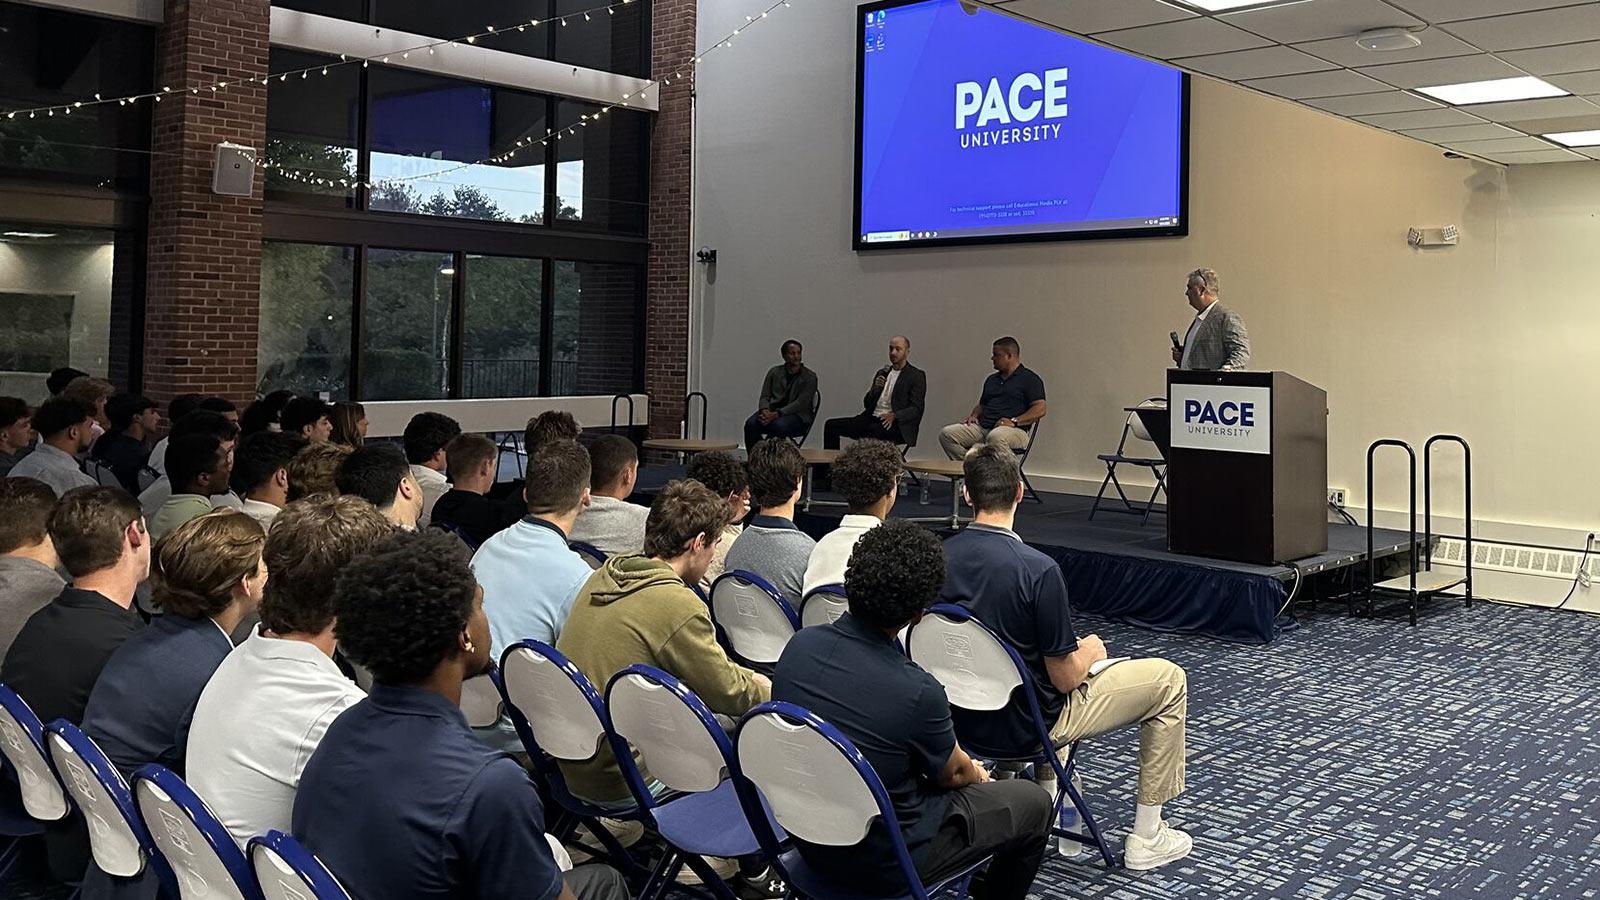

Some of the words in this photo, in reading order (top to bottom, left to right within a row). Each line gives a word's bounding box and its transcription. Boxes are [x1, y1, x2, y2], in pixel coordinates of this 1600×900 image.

[955, 67, 1068, 130] PACE
[960, 123, 1061, 149] UNIVERSITY
[1184, 399, 1255, 427] PACE
[1188, 425, 1251, 437] UNIVERSITY
